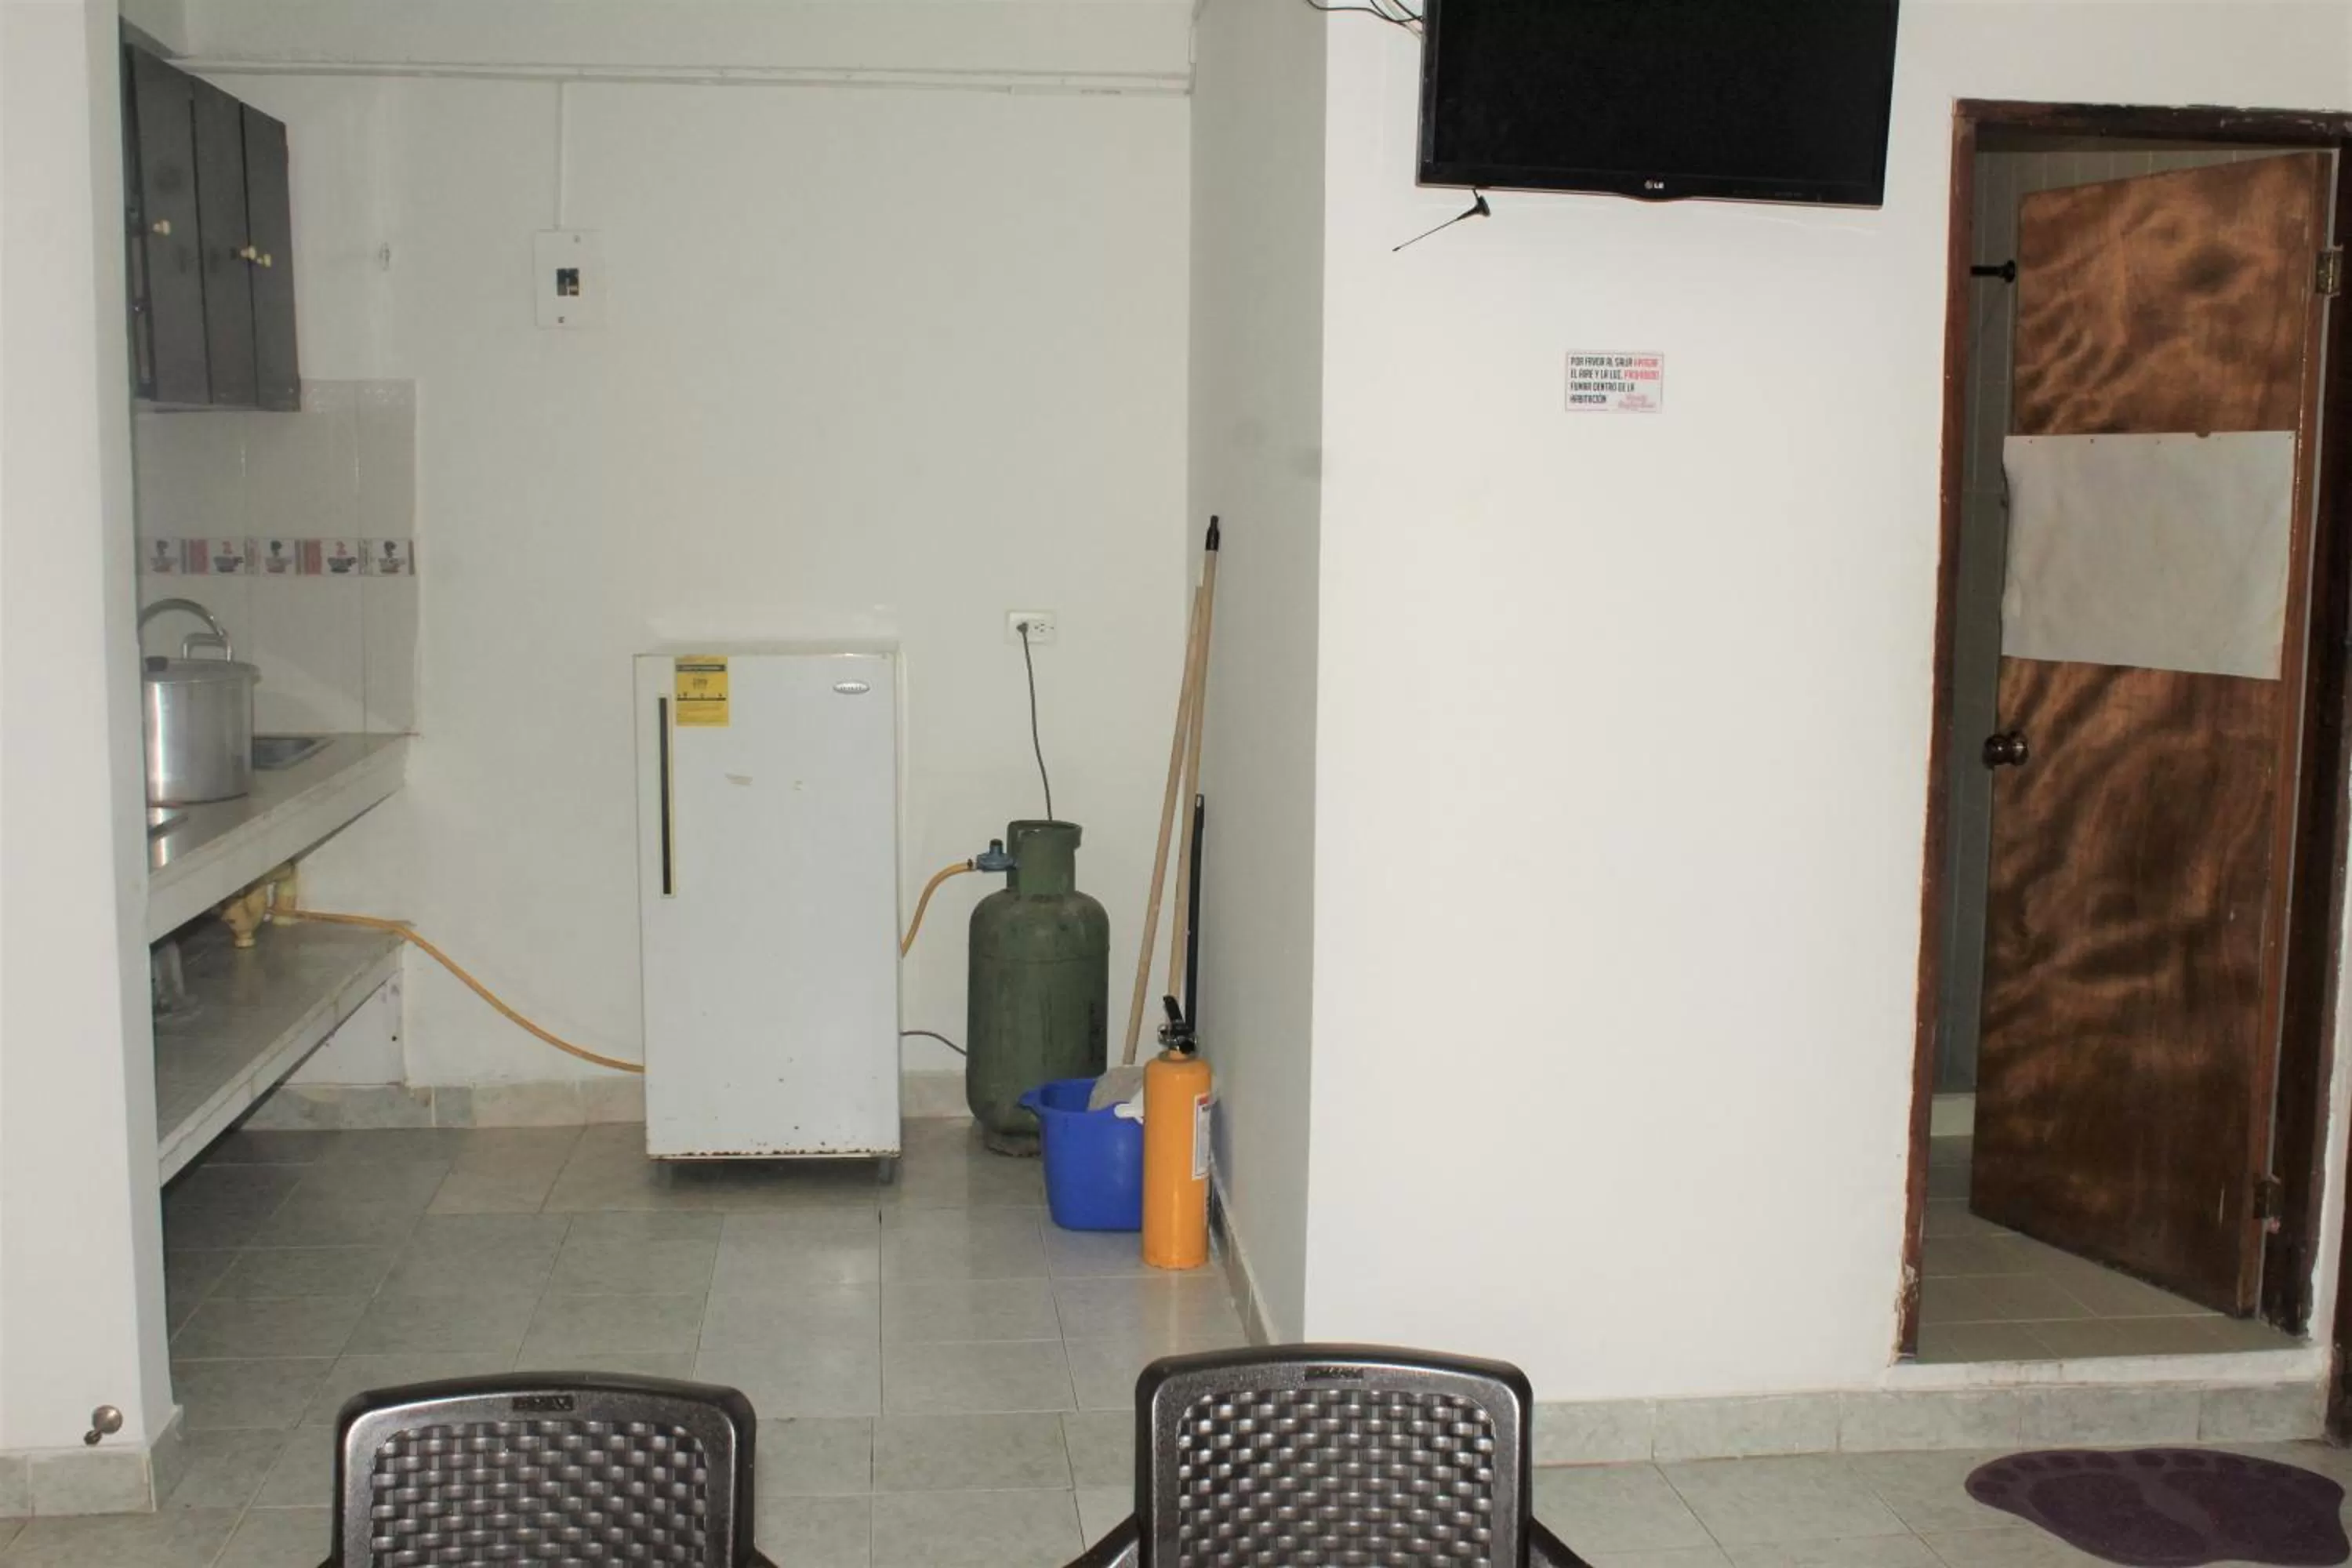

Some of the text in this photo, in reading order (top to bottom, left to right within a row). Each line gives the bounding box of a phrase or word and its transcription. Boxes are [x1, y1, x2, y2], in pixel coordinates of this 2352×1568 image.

[1570, 357, 1584, 366] POR
[1584, 357, 1605, 367] FAVOR
[1605, 357, 1613, 367] AL
[1614, 357, 1632, 367] SALIR
[1570, 369, 1577, 379] EL
[1578, 369, 1592, 379] AIRE
[1594, 369, 1599, 379] Y
[1600, 369, 1609, 379] LA
[1570, 382, 1635, 393] FUMAR DENTRO DE LA
